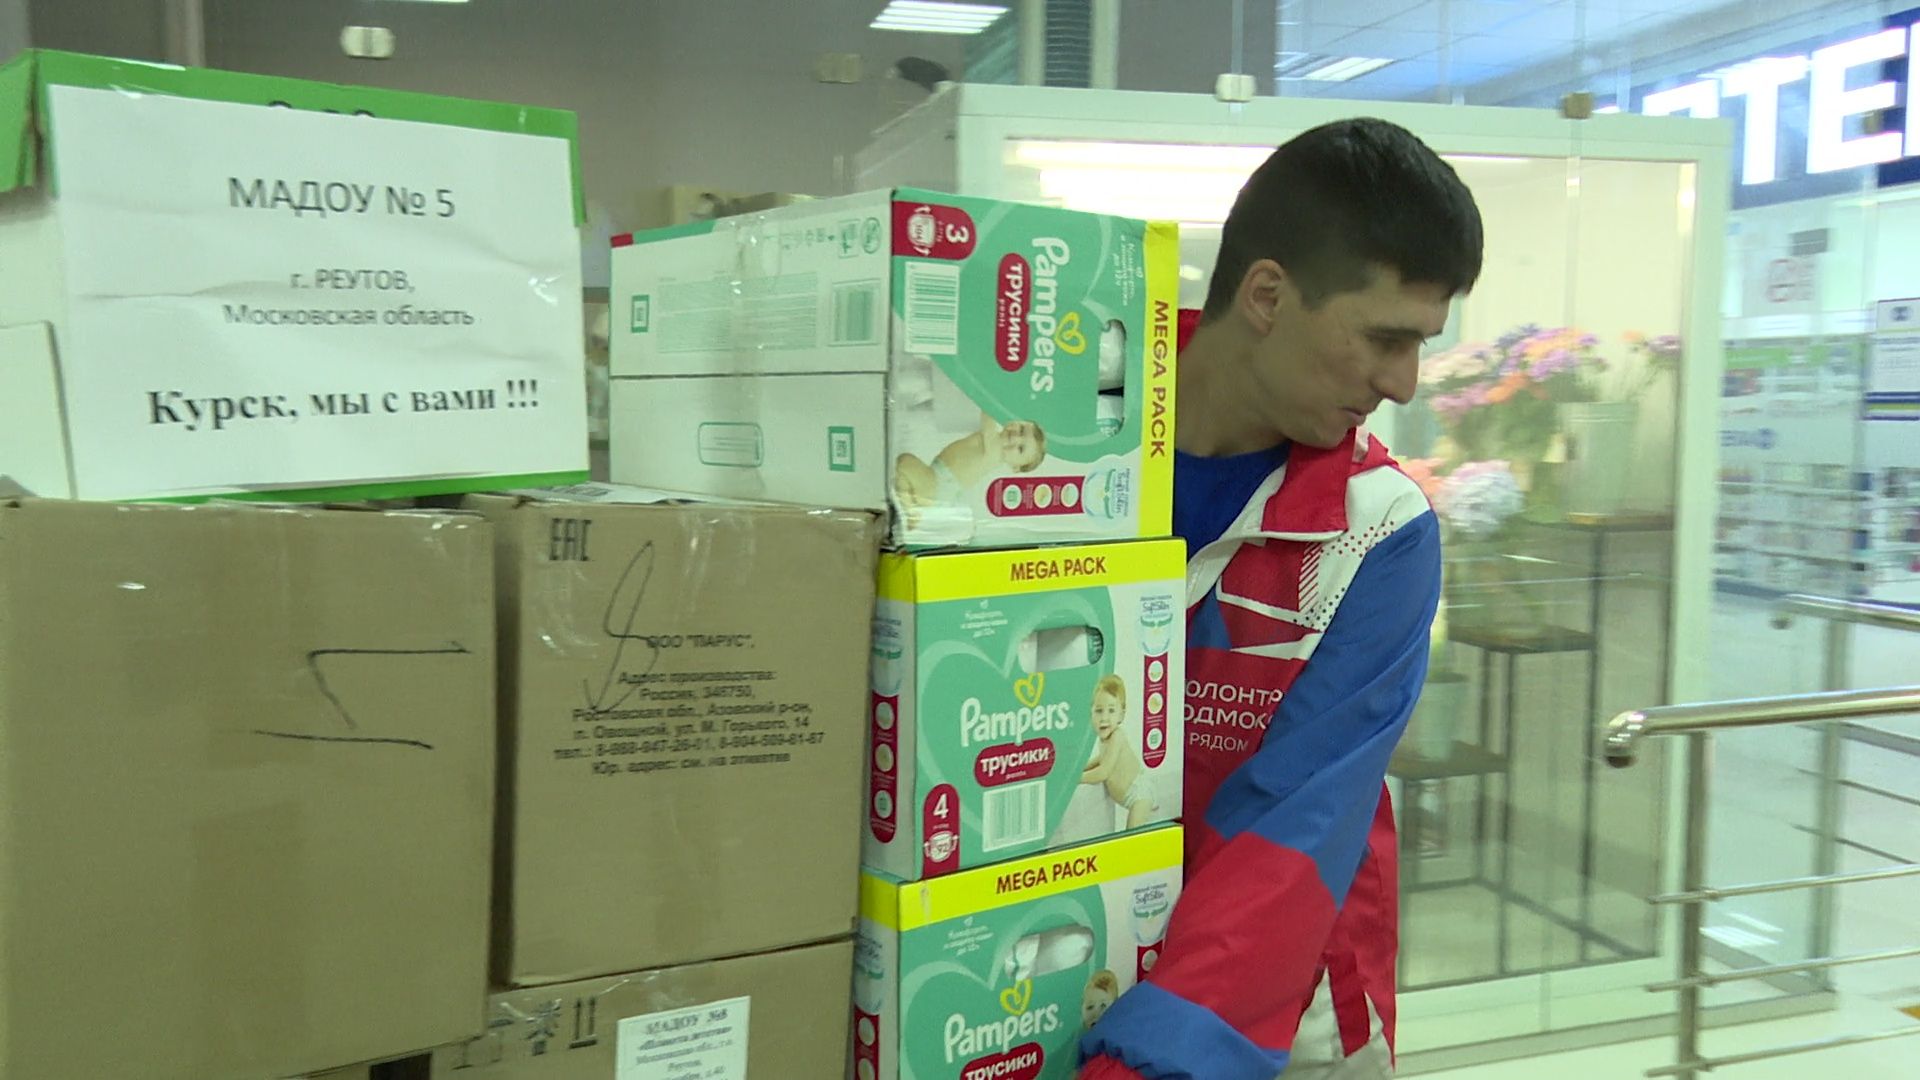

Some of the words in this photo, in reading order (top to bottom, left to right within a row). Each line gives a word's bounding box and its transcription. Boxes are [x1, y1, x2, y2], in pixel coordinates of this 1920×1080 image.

[228, 177, 375, 219] МАДОУ
[386, 186, 426, 216] №
[436, 188, 456, 218] 5
[945, 223, 970, 243] 3
[290, 273, 309, 289] г.
[315, 268, 415, 293] РЕУТОВ,
[223, 304, 378, 325] Московская
[383, 304, 475, 325] область
[1005, 263, 1024, 363] трусики
[1027, 236, 1070, 393] Pampers
[1153, 300, 1169, 378] MEGA
[146, 390, 299, 432] Курск,
[310, 392, 371, 416] мы
[381, 391, 400, 414] с
[410, 388, 497, 413] вами
[505, 379, 539, 408] !!!
[1150, 386, 1167, 459] PACK
[1010, 560, 1060, 581] MEGA
[1064, 556, 1107, 577] PACK
[647, 635, 684, 648] ООО
[618, 671, 667, 685] Адрес
[961, 697, 1070, 747] Pampers
[980, 747, 1050, 777] трусики
[933, 793, 949, 819] 4
[996, 868, 1048, 895] MEGA
[1052, 855, 1099, 882] PACK
[944, 1003, 1059, 1063] Pampers
[965, 1050, 1038, 1080] трусики
